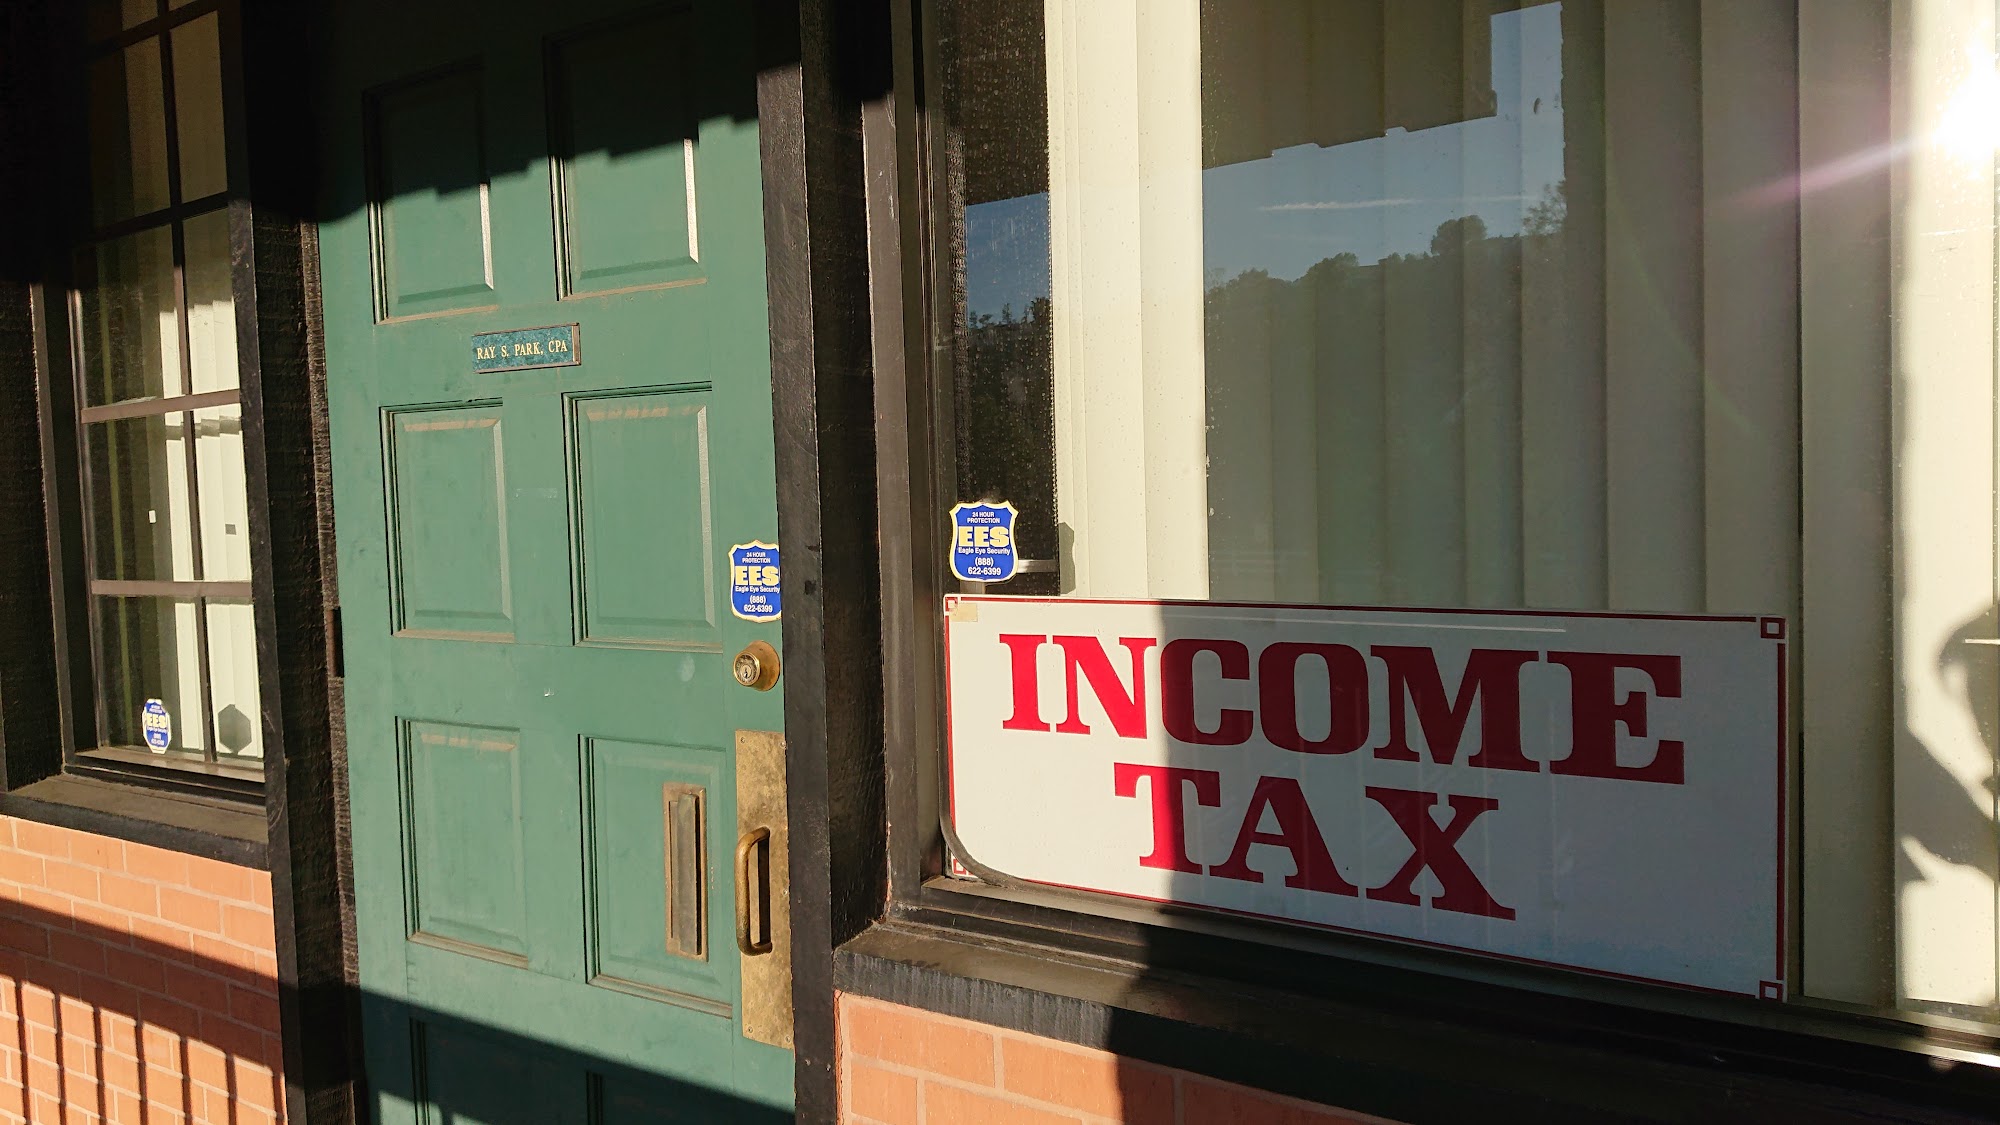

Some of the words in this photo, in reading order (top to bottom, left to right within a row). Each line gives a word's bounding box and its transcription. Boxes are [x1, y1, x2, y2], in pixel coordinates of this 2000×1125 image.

[501, 345, 509, 358] S.
[514, 342, 544, 356] PARK,
[548, 340, 568, 353] CPA
[958, 526, 1009, 548] EES
[958, 547, 974, 555] Eagle
[975, 547, 986, 555] Eye
[987, 547, 1010, 556] Security
[975, 557, 994, 567] (888)
[735, 565, 779, 586] EES
[968, 567, 1001, 576] 622-6399
[760, 586, 780, 594] Security
[750, 595, 766, 604] (888)
[743, 604, 773, 613] 622-6399
[999, 633, 1685, 785] INCOME
[146, 712, 167, 729] EES
[1114, 762, 1517, 921] TAX
